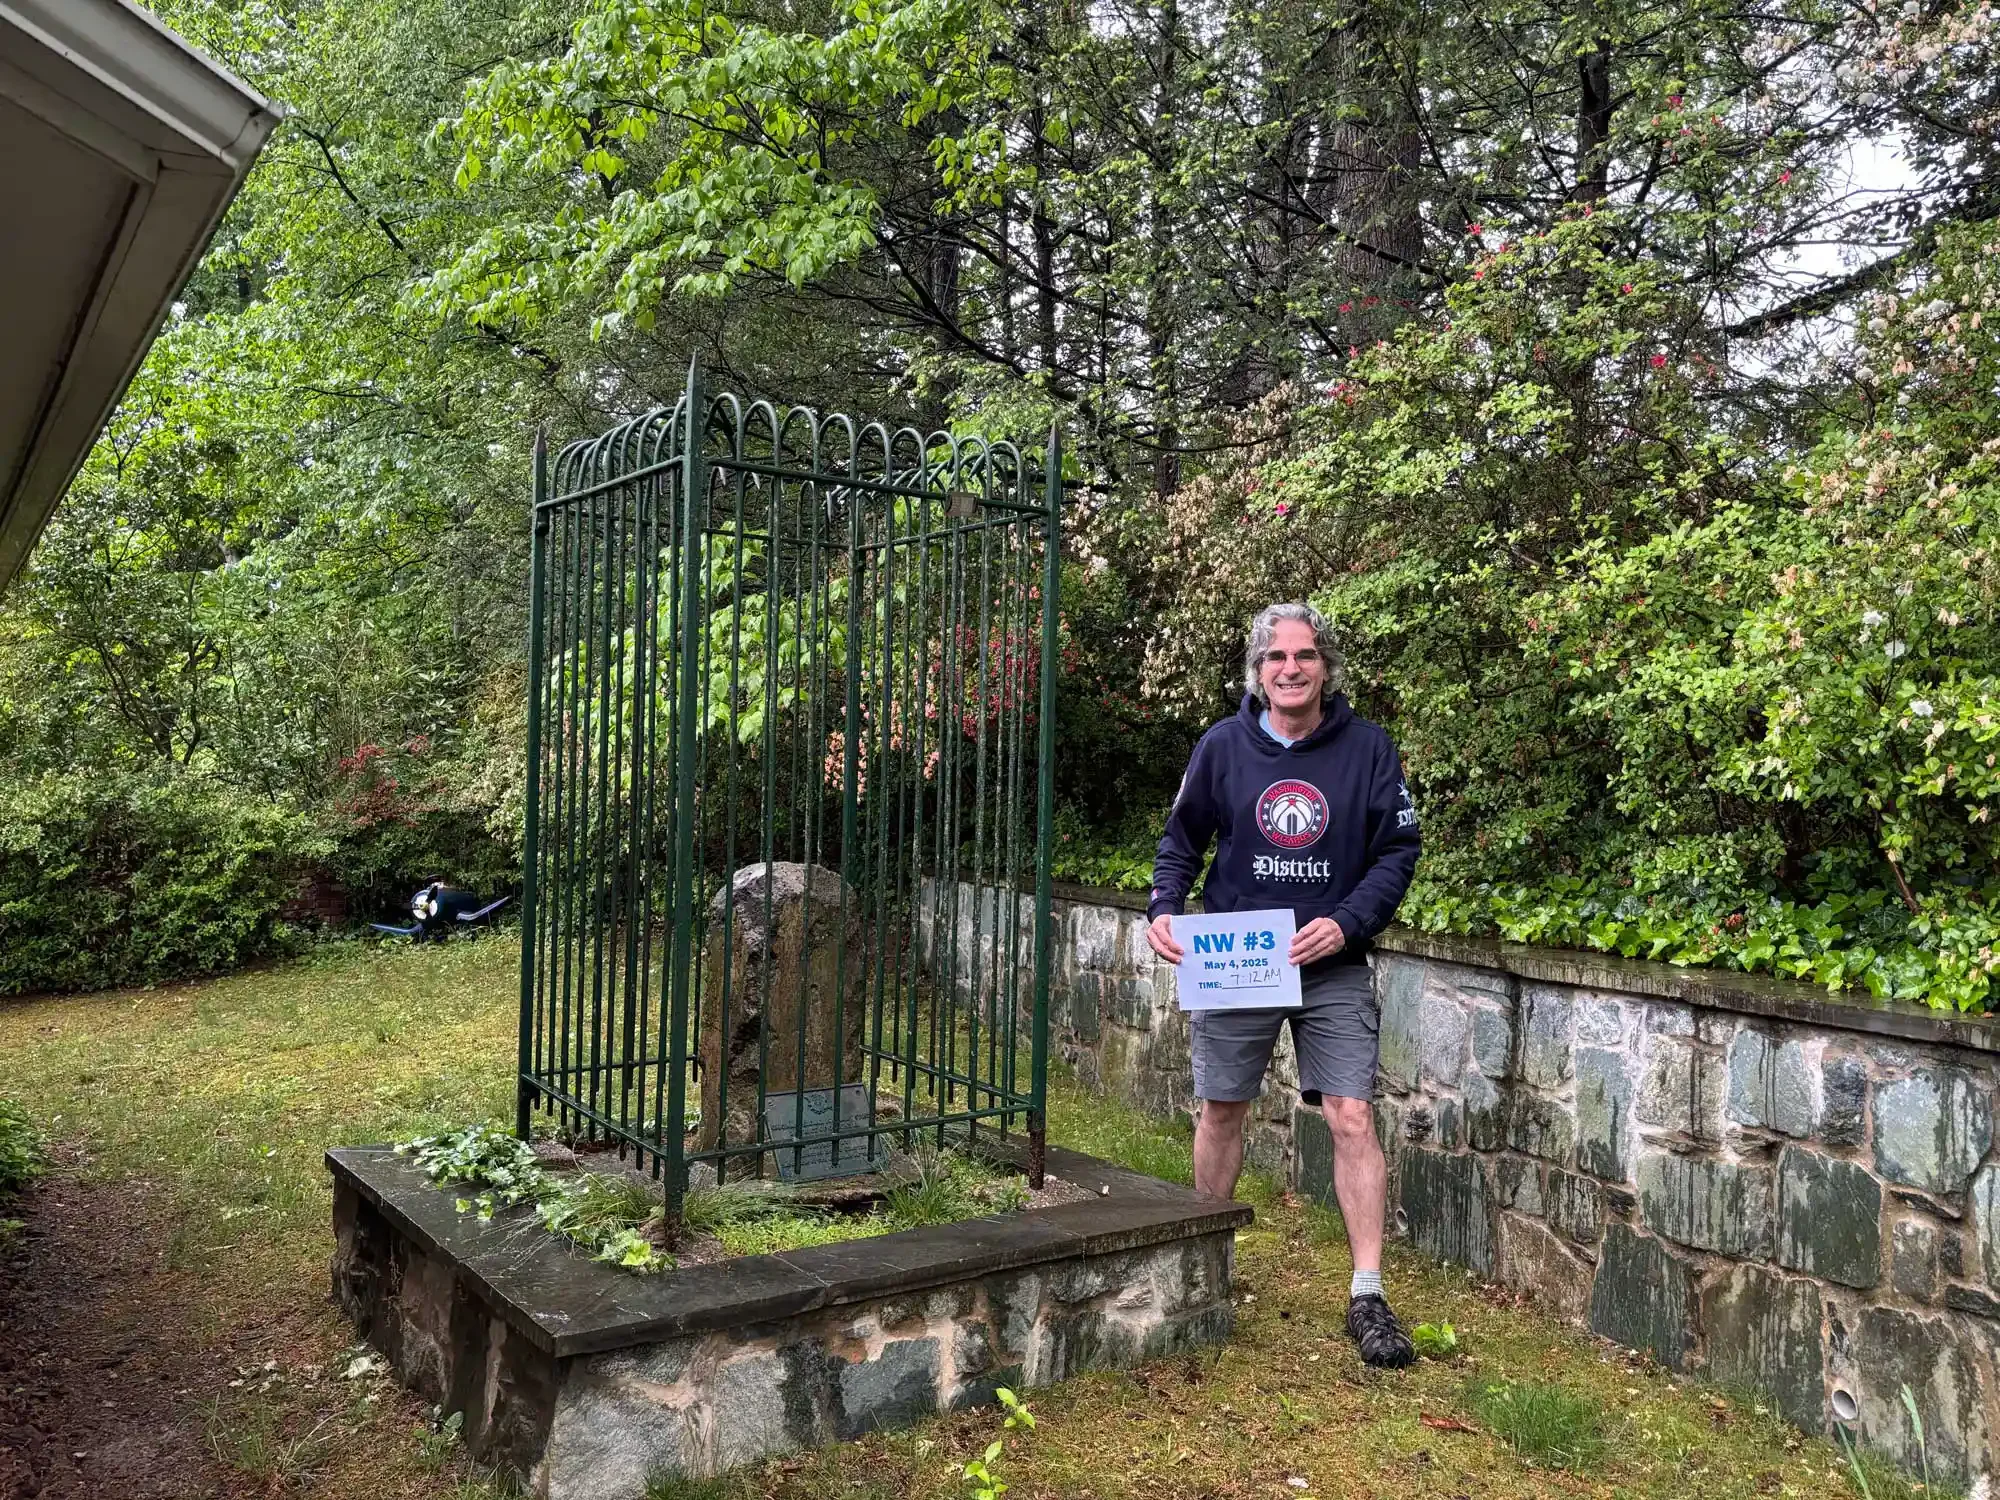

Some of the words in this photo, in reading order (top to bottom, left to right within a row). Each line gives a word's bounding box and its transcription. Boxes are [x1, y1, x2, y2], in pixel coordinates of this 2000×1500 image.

[1266, 784, 1318, 801] WASHINGTON
[1253, 854, 1331, 878] District
[1193, 932, 1235, 954] NW
[1243, 930, 1275, 951] #3
[1204, 961, 1226, 971] May
[1229, 960, 1239, 970] 4,
[1241, 958, 1269, 968] 2025
[1230, 971, 1262, 985] 7:12
[1263, 967, 1282, 982] AM
[1198, 981, 1223, 989] TIME:
